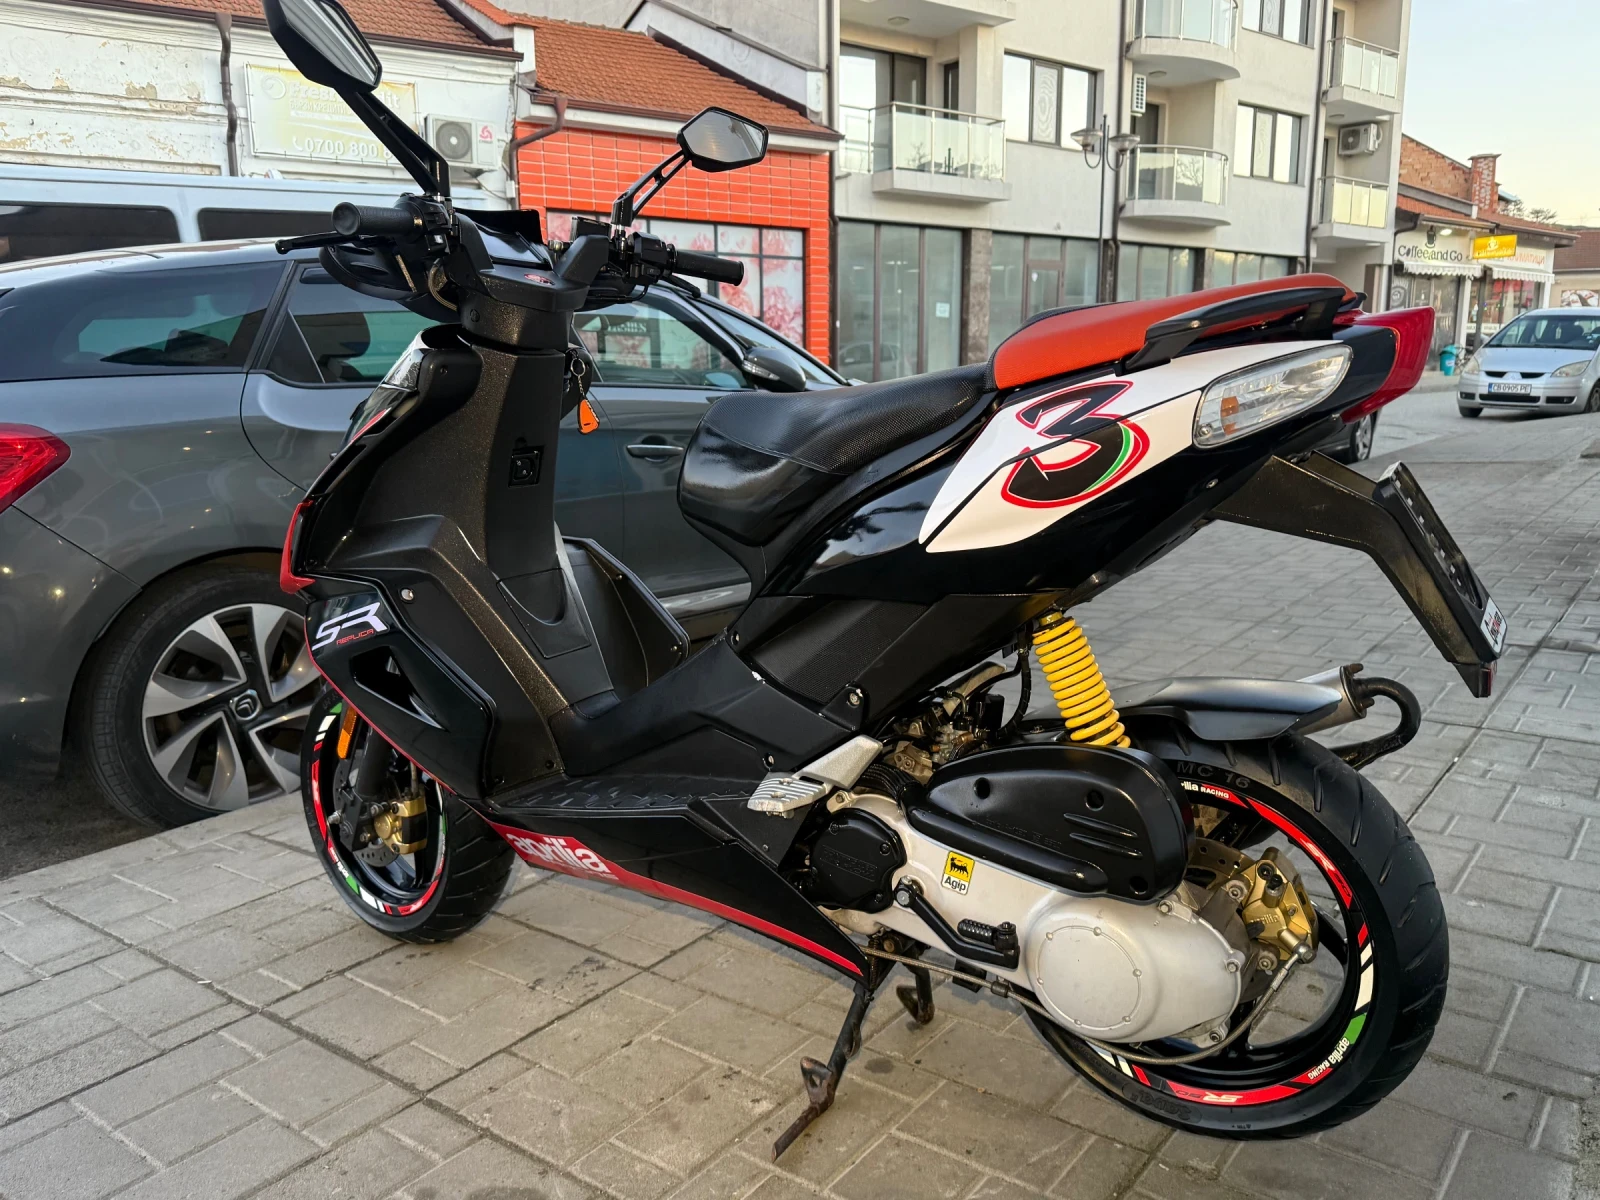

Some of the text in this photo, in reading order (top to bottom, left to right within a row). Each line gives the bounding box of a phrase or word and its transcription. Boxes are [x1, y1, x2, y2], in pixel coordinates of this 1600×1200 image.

[304, 137, 345, 155] 0700
[351, 142, 378, 157] 800
[1398, 244, 1429, 259] Coffee
[1430, 249, 1448, 261] and
[1449, 250, 1463, 262] Go
[311, 601, 388, 651] SR
[336, 628, 374, 645] REPLICA
[1200, 786, 1230, 799] RACING
[506, 833, 612, 873] aprilia
[944, 876, 967, 891] Agip
[1307, 1037, 1350, 1080] aprilia RACING
